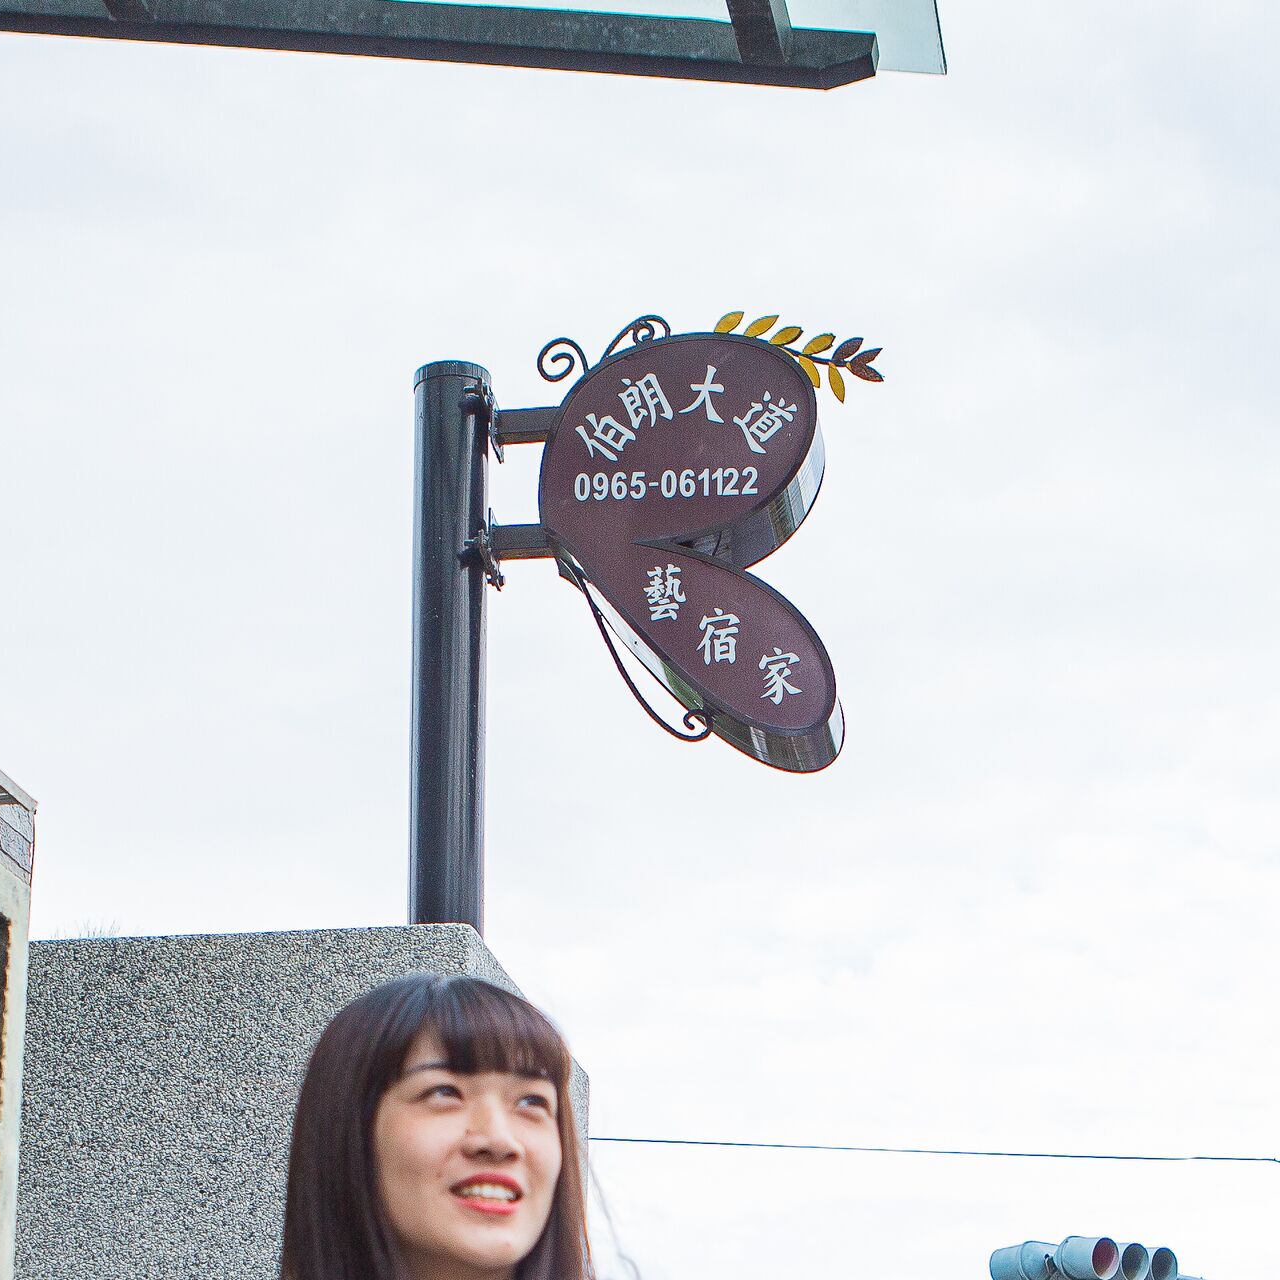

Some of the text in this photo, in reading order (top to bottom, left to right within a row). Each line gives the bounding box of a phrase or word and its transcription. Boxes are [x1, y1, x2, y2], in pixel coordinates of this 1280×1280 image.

[575, 365, 797, 462] 伯朗大道
[574, 467, 759, 502] 0965-061122
[644, 564, 803, 705] 藝宿家
